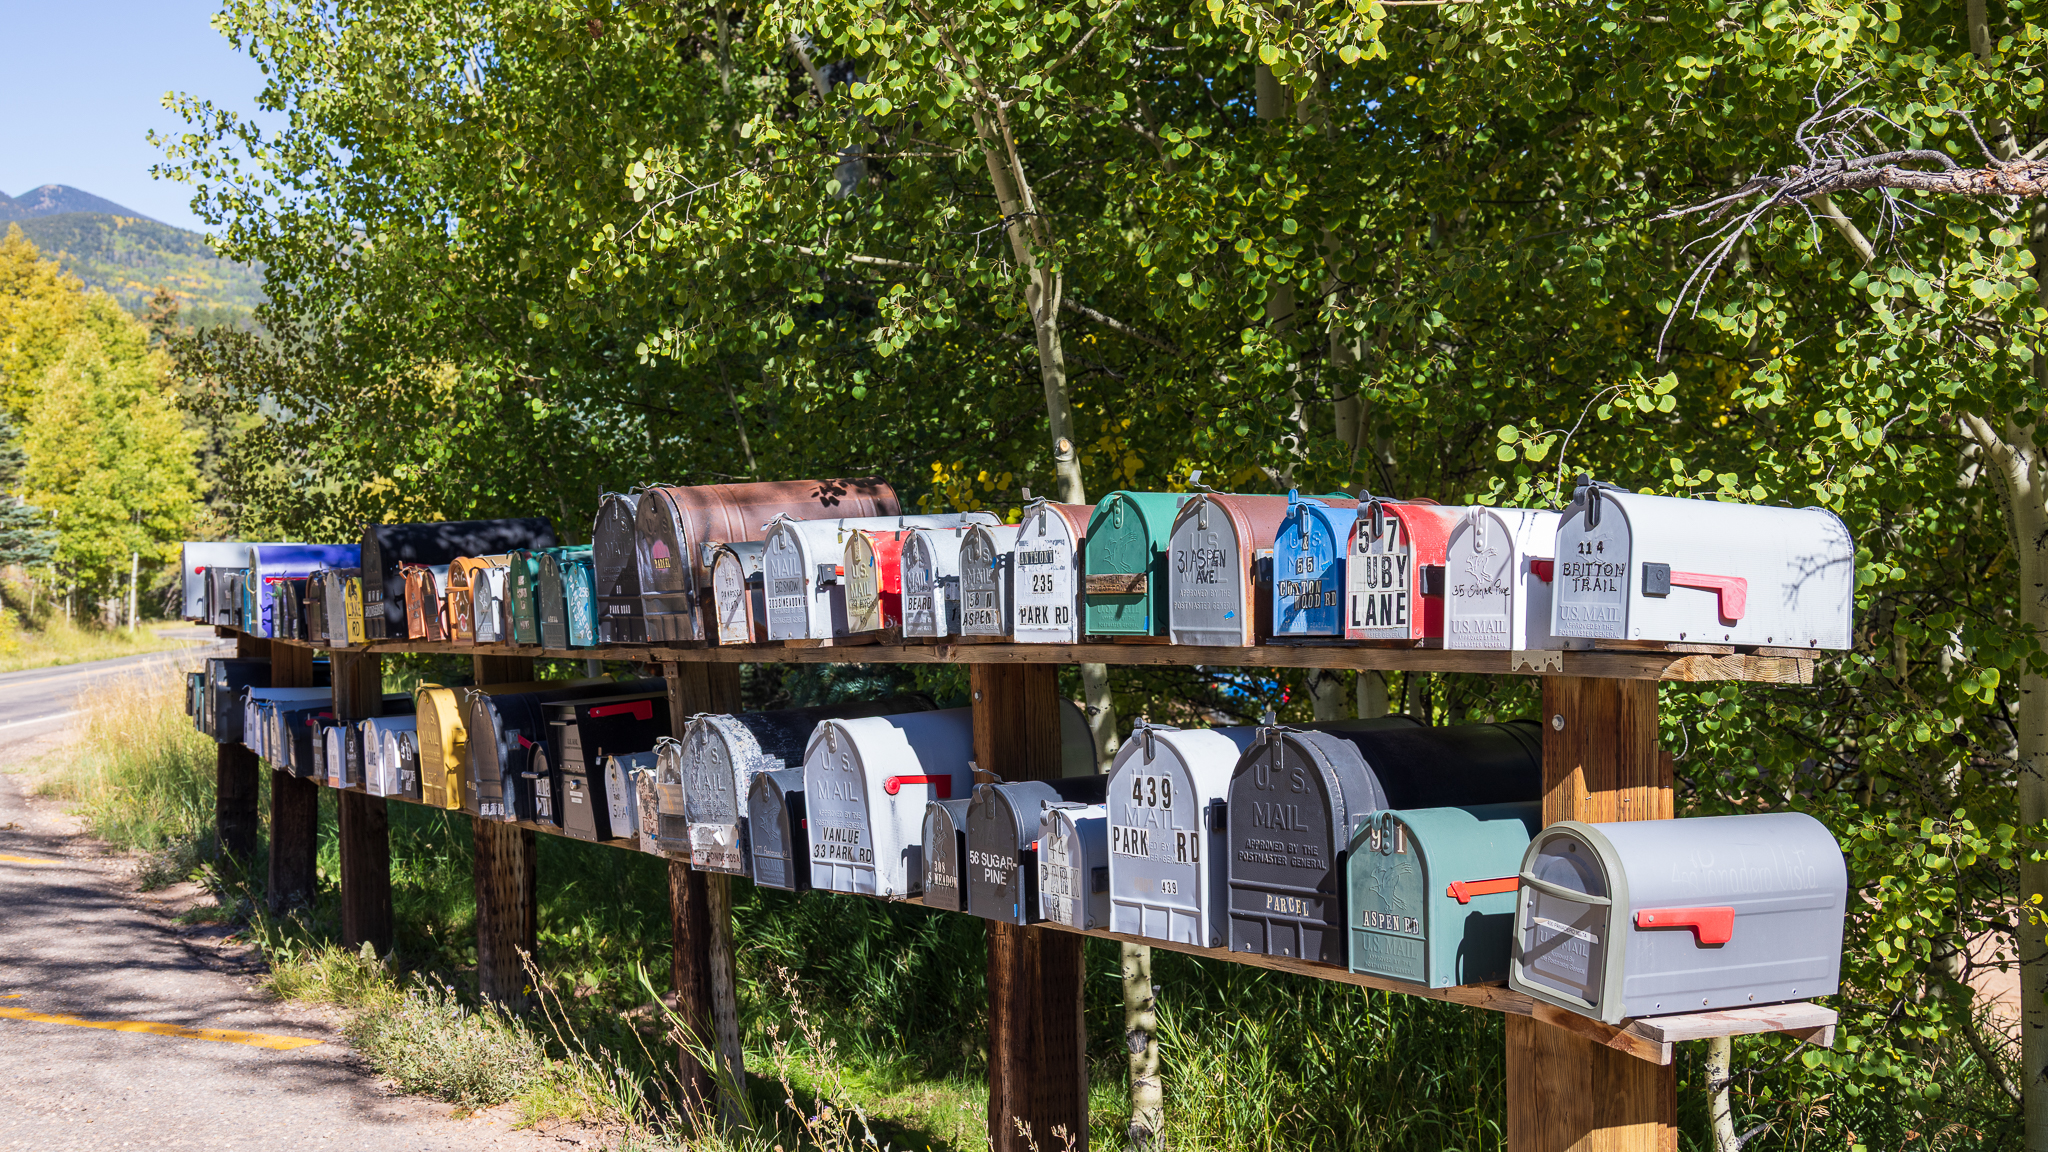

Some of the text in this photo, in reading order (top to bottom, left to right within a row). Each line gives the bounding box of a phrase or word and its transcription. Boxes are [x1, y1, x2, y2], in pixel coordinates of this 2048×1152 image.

[1577, 541, 1604, 554] 114
[771, 557, 801, 577] MAIL
[1020, 551, 1054, 565] ANTHONY
[1190, 548, 1226, 568] ASPEN
[1297, 557, 1313, 574] 55
[966, 567, 992, 585] MAIL
[1562, 562, 1626, 577] BRITTON
[850, 581, 872, 598] MAIL
[1033, 574, 1053, 592] 235
[1279, 580, 1322, 596] COTTON
[1452, 584, 1465, 597] 35
[1573, 578, 1618, 592] TRAIL
[1179, 589, 1231, 598] APPROVED BY THE
[1294, 591, 1336, 610] WOOD RD
[908, 596, 932, 610] BEARD
[1174, 602, 1238, 611] POSTMASTER GENERAL
[1352, 593, 1406, 627] LANE
[963, 610, 991, 626] ASPEN
[1020, 606, 1069, 624] PARK RD
[1560, 605, 1623, 623] U.S. MAIL
[1451, 620, 1508, 634] U.S. MAIL
[1558, 629, 1621, 639] POSTMASTER GENERAL
[1565, 622, 1593, 630] APPROVED
[1602, 623, 1614, 631] THE
[691, 772, 726, 792] MAIL
[817, 780, 858, 802] MAIL
[1132, 777, 1171, 809] 439
[818, 809, 862, 820] APPROVED BY THE
[1125, 803, 1183, 831] MAIL
[1253, 801, 1308, 832] MAIL
[823, 828, 859, 844] VANLUE
[1113, 826, 1149, 856] PARK
[1177, 832, 1199, 862] RD
[814, 844, 872, 863] 33 PARK RD
[1048, 835, 1066, 861] 44
[1245, 838, 1319, 856] APPROVED BY THE
[969, 850, 979, 864] 56
[1238, 851, 1327, 870] POSTMASTER GENERAL
[1766, 842, 1819, 891] Vista
[984, 868, 1007, 886] PINE
[1041, 864, 1080, 898] PARK
[1162, 880, 1177, 894] 439
[1266, 894, 1309, 917] PARCEL
[1363, 910, 1420, 935] ASPEN RD
[1361, 934, 1419, 959] U.S. MAIL
[1561, 939, 1588, 958] MAIL
